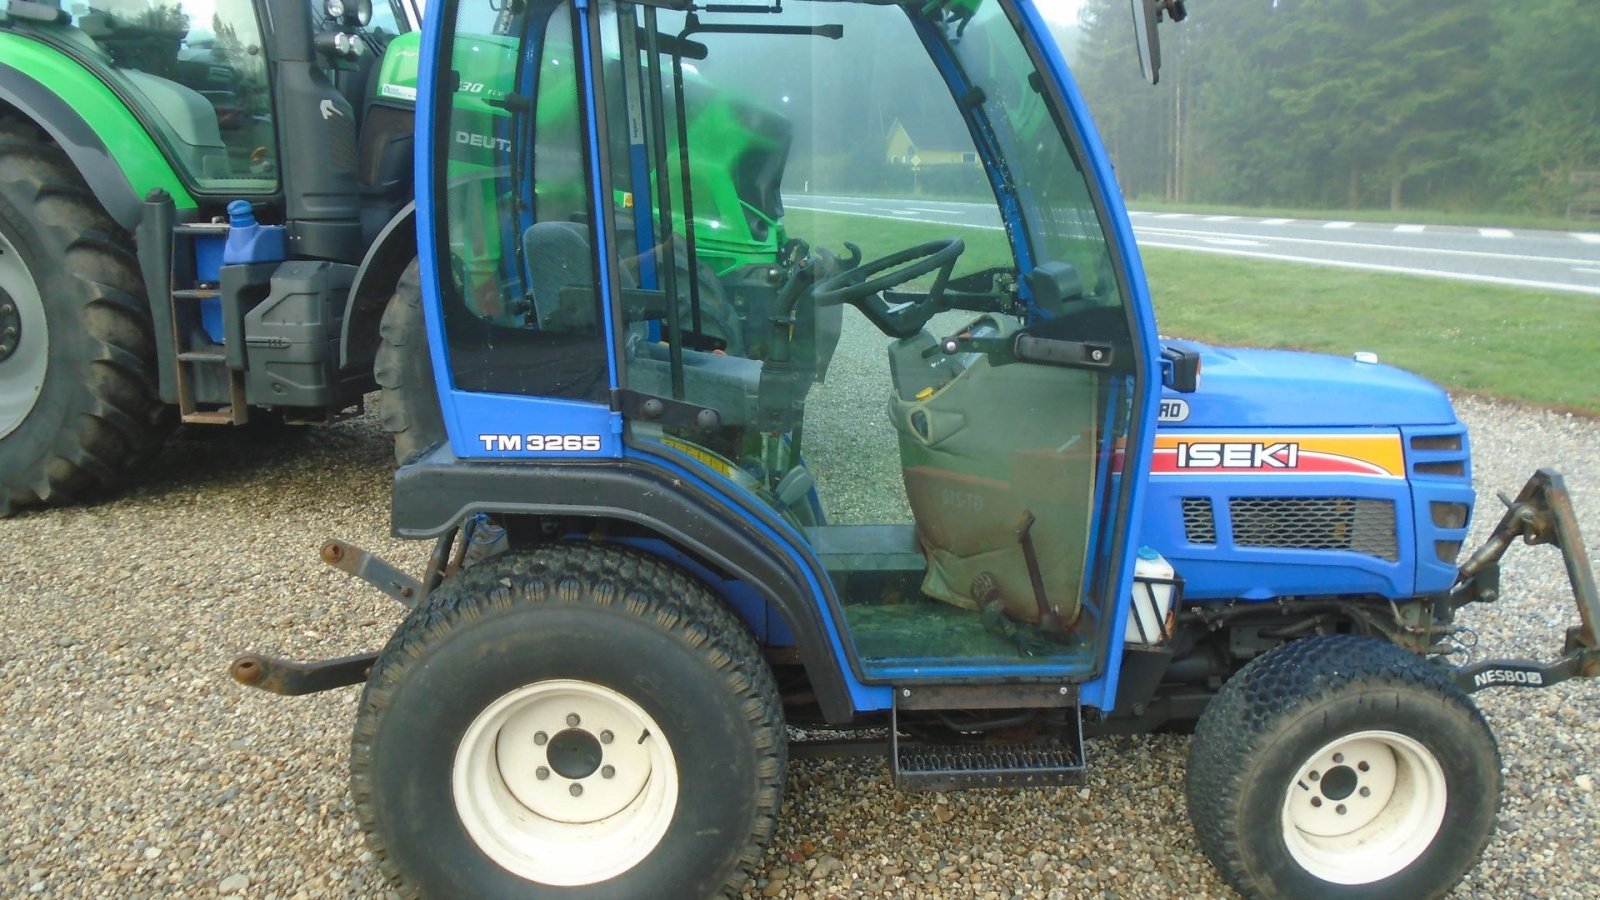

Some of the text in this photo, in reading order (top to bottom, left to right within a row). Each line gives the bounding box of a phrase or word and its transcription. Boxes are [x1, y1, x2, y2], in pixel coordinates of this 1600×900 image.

[479, 434, 601, 451] TM 3265
[1177, 442, 1299, 468] ISEKI
[1474, 669, 1526, 687] NESBO
